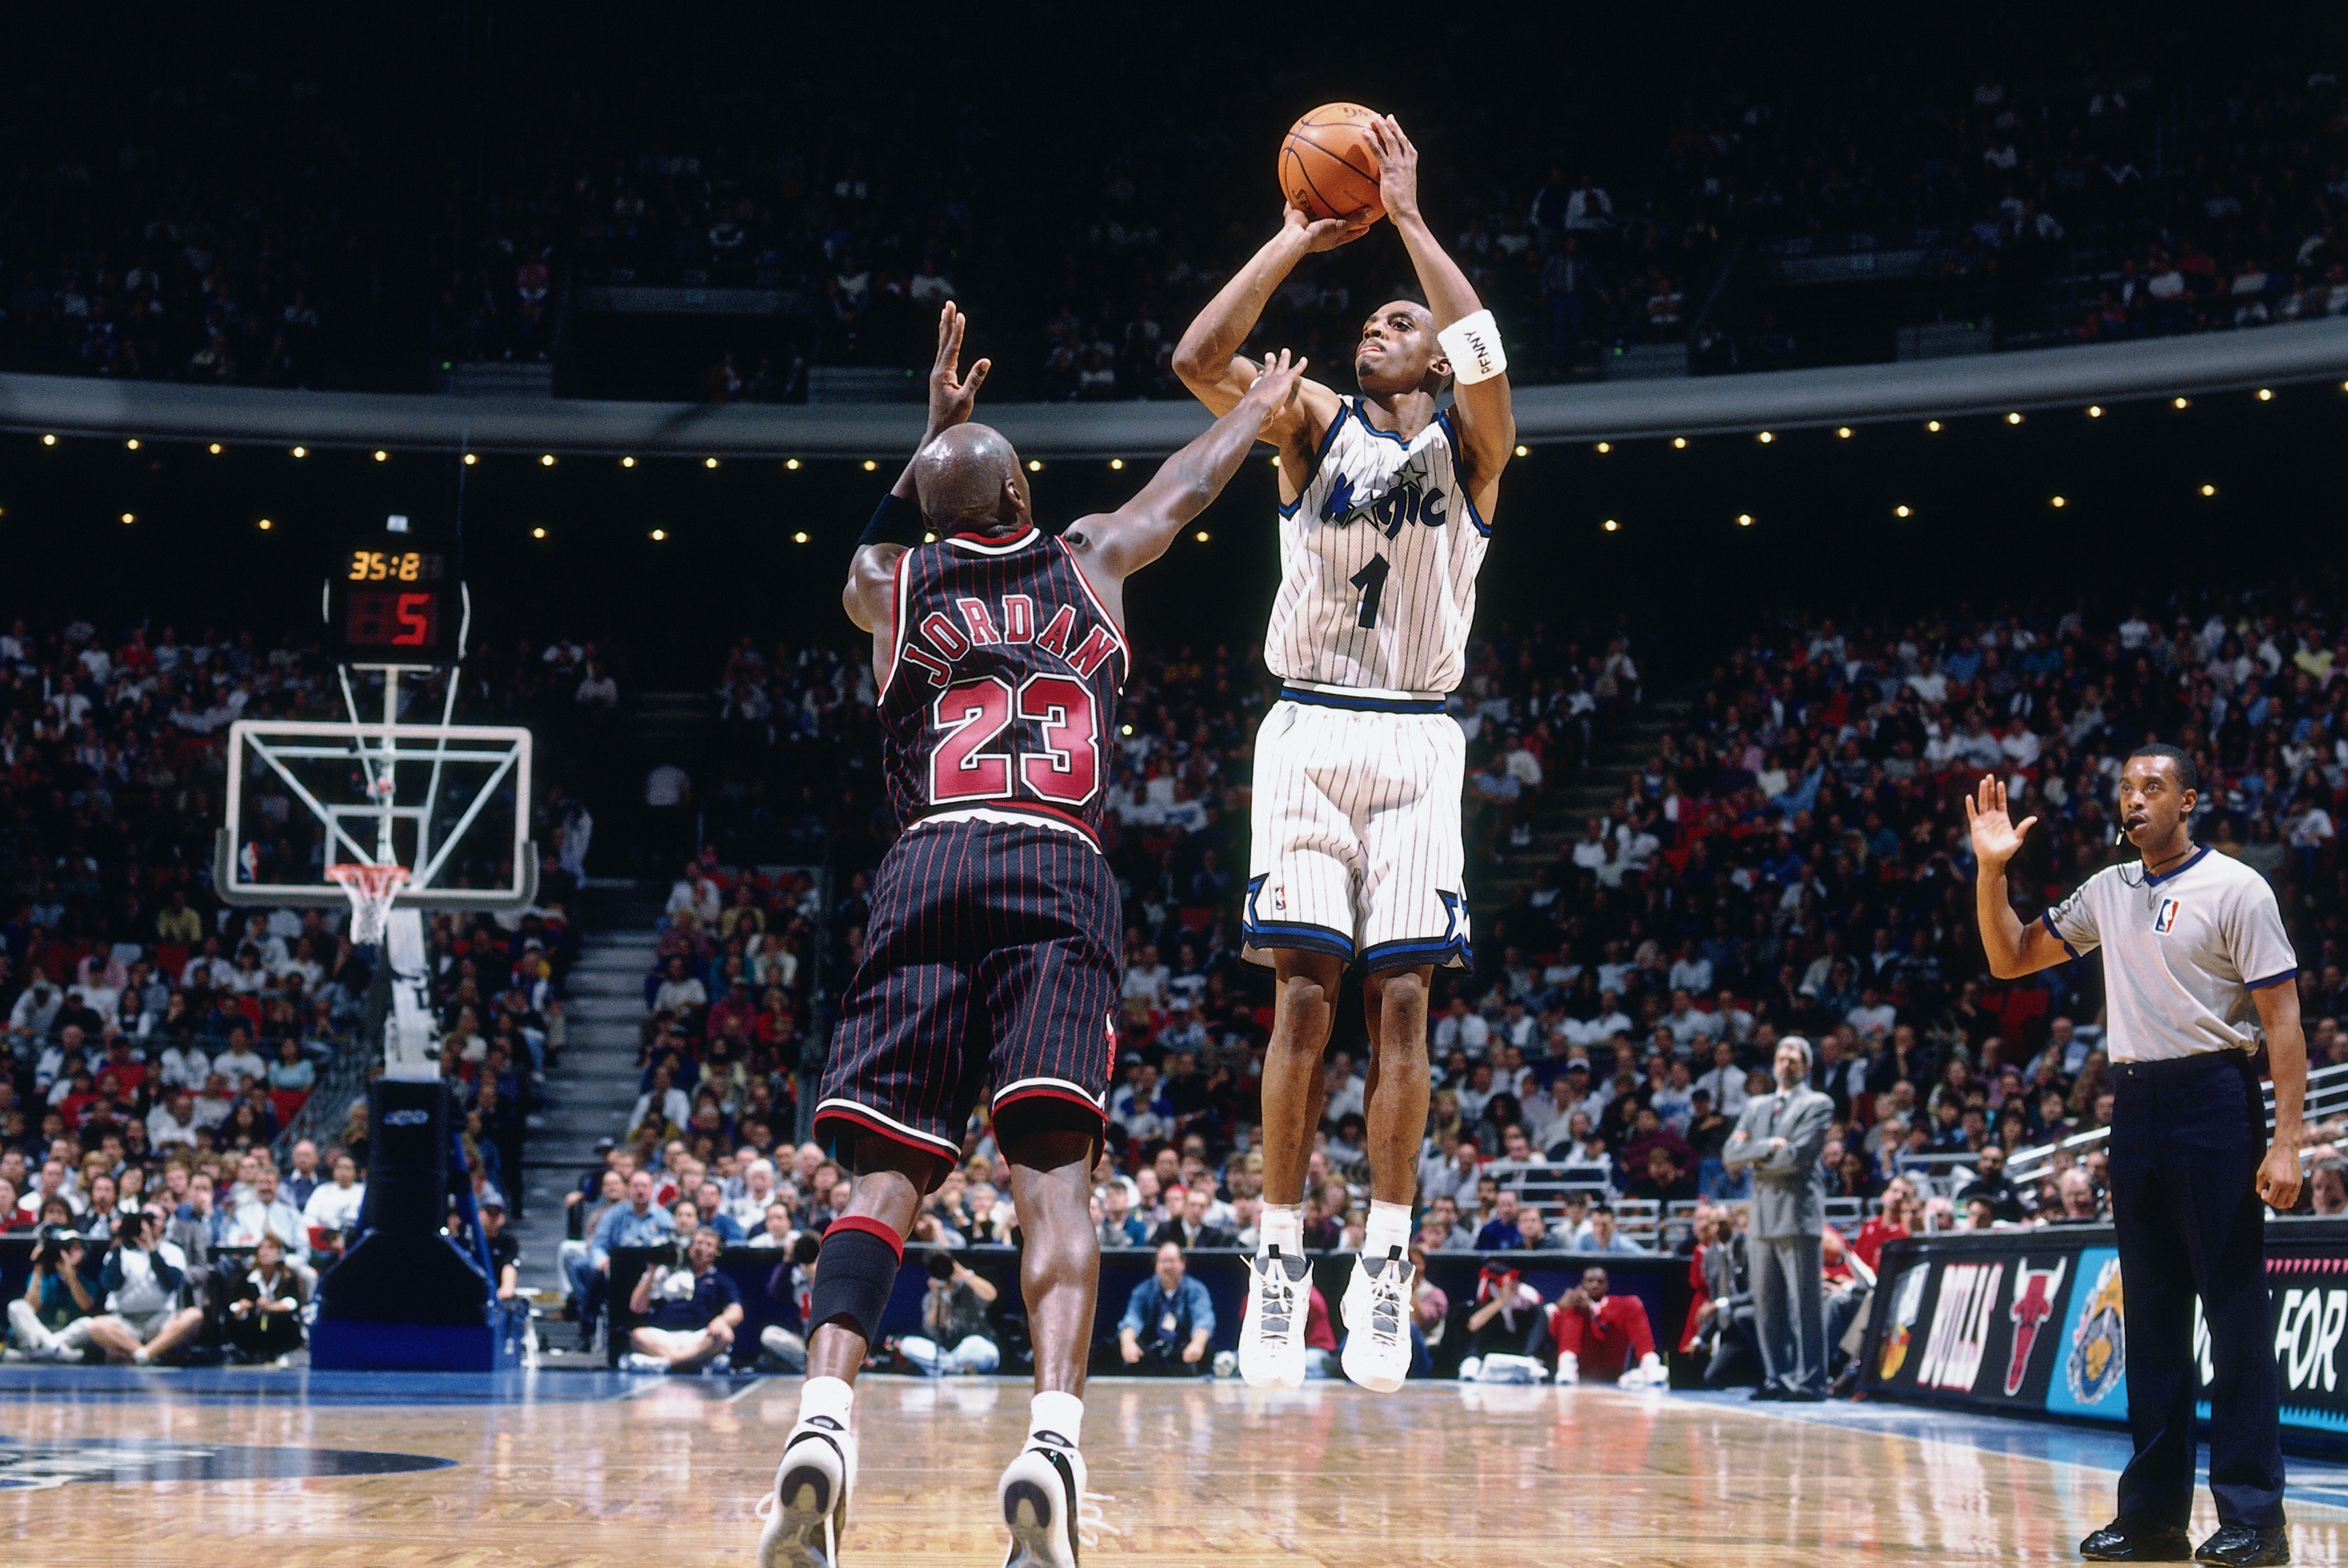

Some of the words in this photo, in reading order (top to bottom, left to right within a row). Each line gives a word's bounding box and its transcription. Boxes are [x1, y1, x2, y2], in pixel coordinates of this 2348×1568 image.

[1464, 331, 1493, 374] PENNY
[392, 593, 431, 645] 5
[1350, 553, 1390, 629] 1
[901, 595, 1119, 688] JORDAN
[930, 672, 1099, 806] 23
[1917, 1261, 2004, 1394] BULLS
